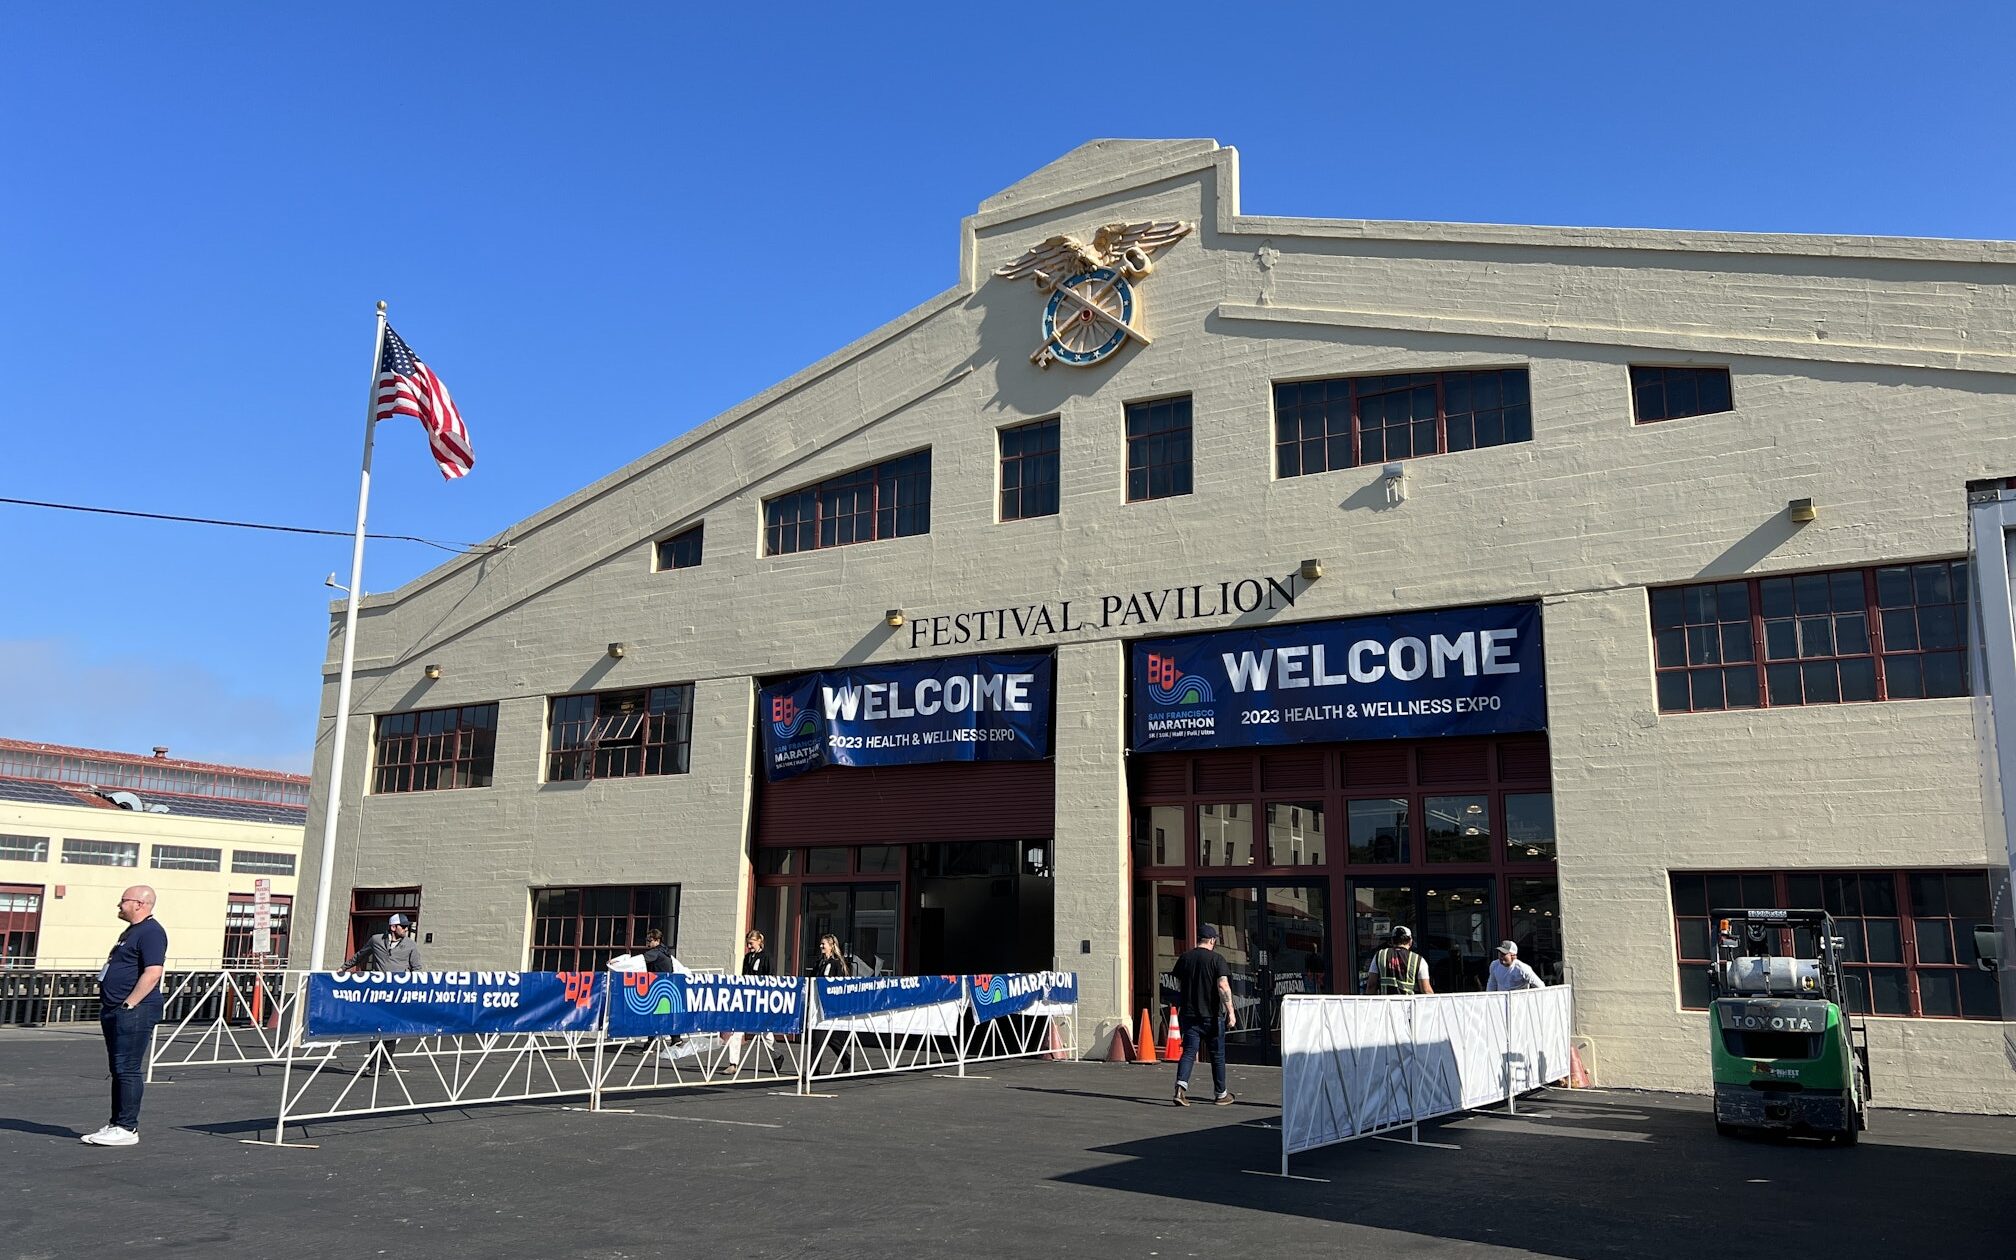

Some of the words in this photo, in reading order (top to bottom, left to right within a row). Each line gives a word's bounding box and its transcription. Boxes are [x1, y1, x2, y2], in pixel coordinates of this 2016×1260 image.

[908, 601, 1083, 649] FESTIVAL
[1100, 573, 1299, 629] PAVILION
[1222, 628, 1521, 694] WELCOME
[822, 673, 1034, 721] WELCOME
[1166, 709, 1215, 719] FRANCISCO
[1241, 709, 1280, 724] 2023
[1284, 704, 1343, 722] HEALTH
[1346, 703, 1358, 718] &
[1361, 698, 1452, 717] WELLNESS
[1456, 695, 1501, 712] EXPO
[1148, 717, 1215, 731] MARATHON
[828, 734, 863, 749] 2023
[865, 733, 910, 748] HEALTH
[912, 733, 921, 746] &
[922, 728, 987, 745] WELLNESS
[989, 729, 1015, 742] EXPO
[774, 744, 820, 763] MARATH
[331, 971, 471, 985] FRANCISCO
[477, 971, 521, 986] SAN
[685, 974, 714, 985] SAN
[718, 975, 798, 988] FRANCISCO
[901, 976, 920, 989] 2023
[332, 988, 360, 1002] Ultra
[369, 988, 394, 1002] Full
[402, 990, 427, 1003] Half
[435, 990, 456, 1003] 10K
[463, 991, 477, 1003] 5K
[482, 991, 520, 1008] 2023
[686, 988, 796, 1014] MARATHON
[1733, 1015, 1813, 1030] TOYOTA
